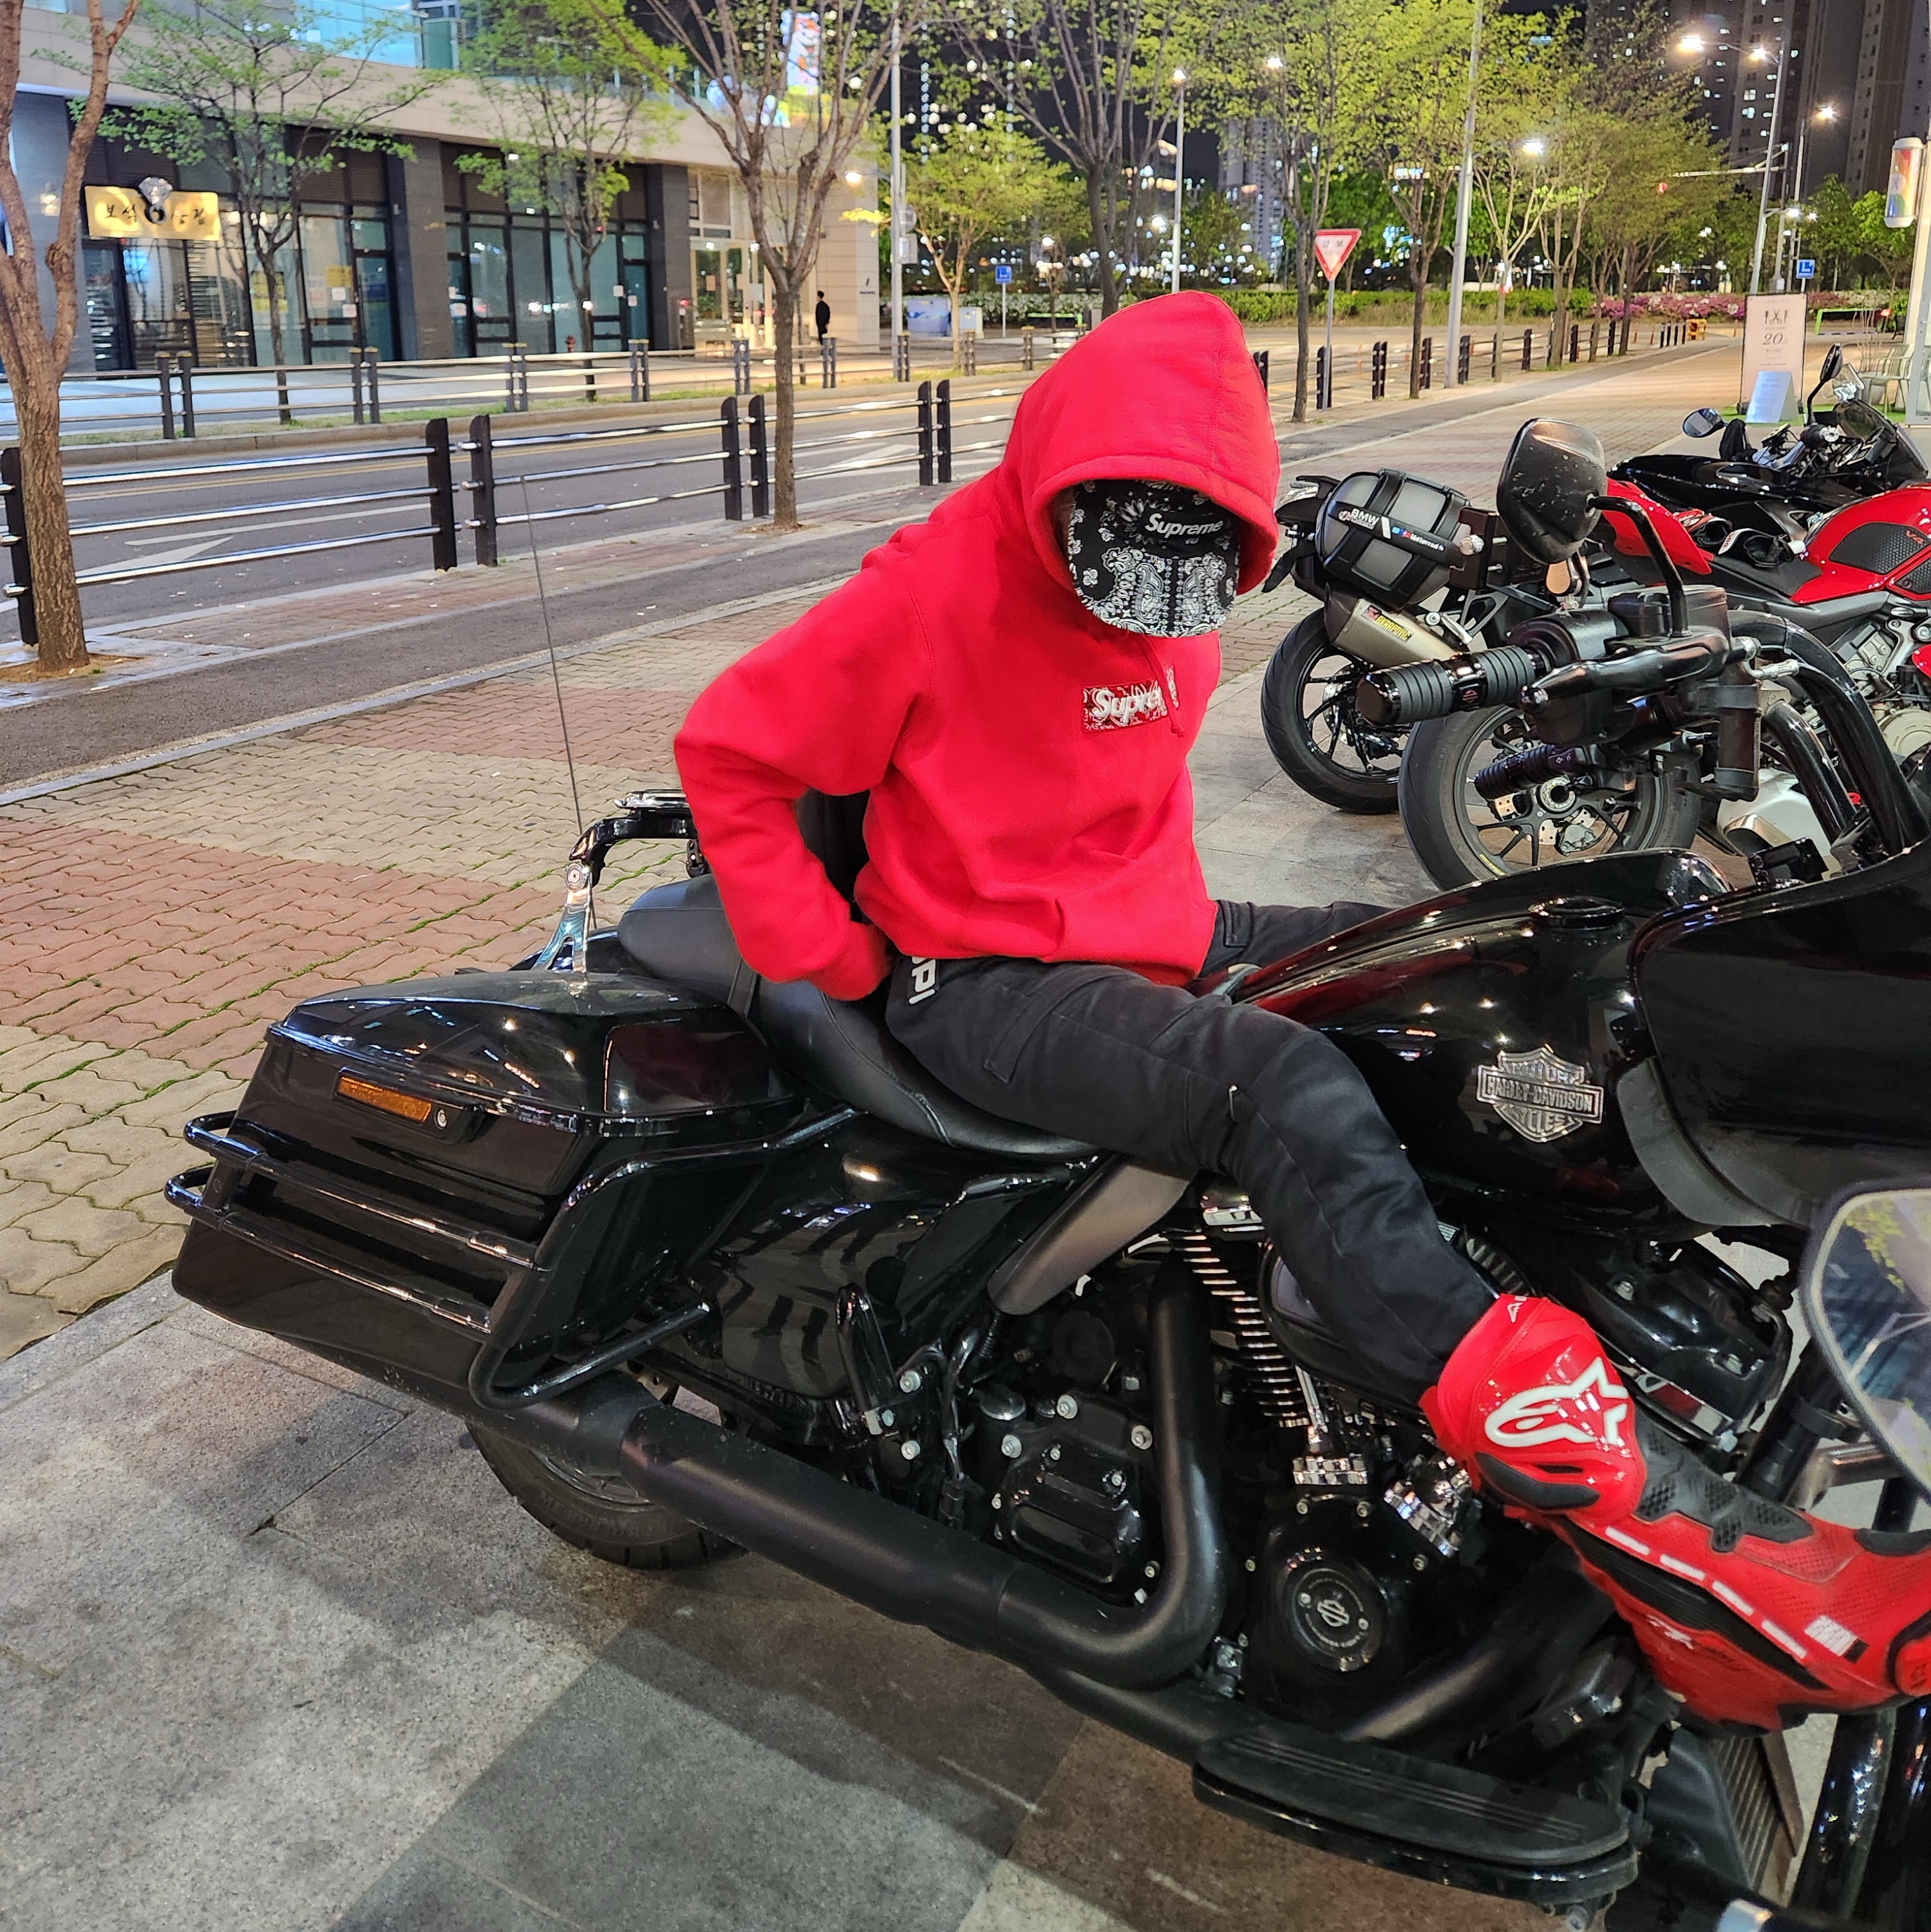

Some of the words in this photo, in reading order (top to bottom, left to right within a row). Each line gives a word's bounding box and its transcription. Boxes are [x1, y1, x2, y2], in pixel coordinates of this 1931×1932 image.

[1145, 513, 1223, 538] Supreme
[1351, 508, 1379, 525] BMW
[1409, 533, 1439, 550] Motorrad
[1486, 1075, 1594, 1112] HARLEY-DAVIDSON
